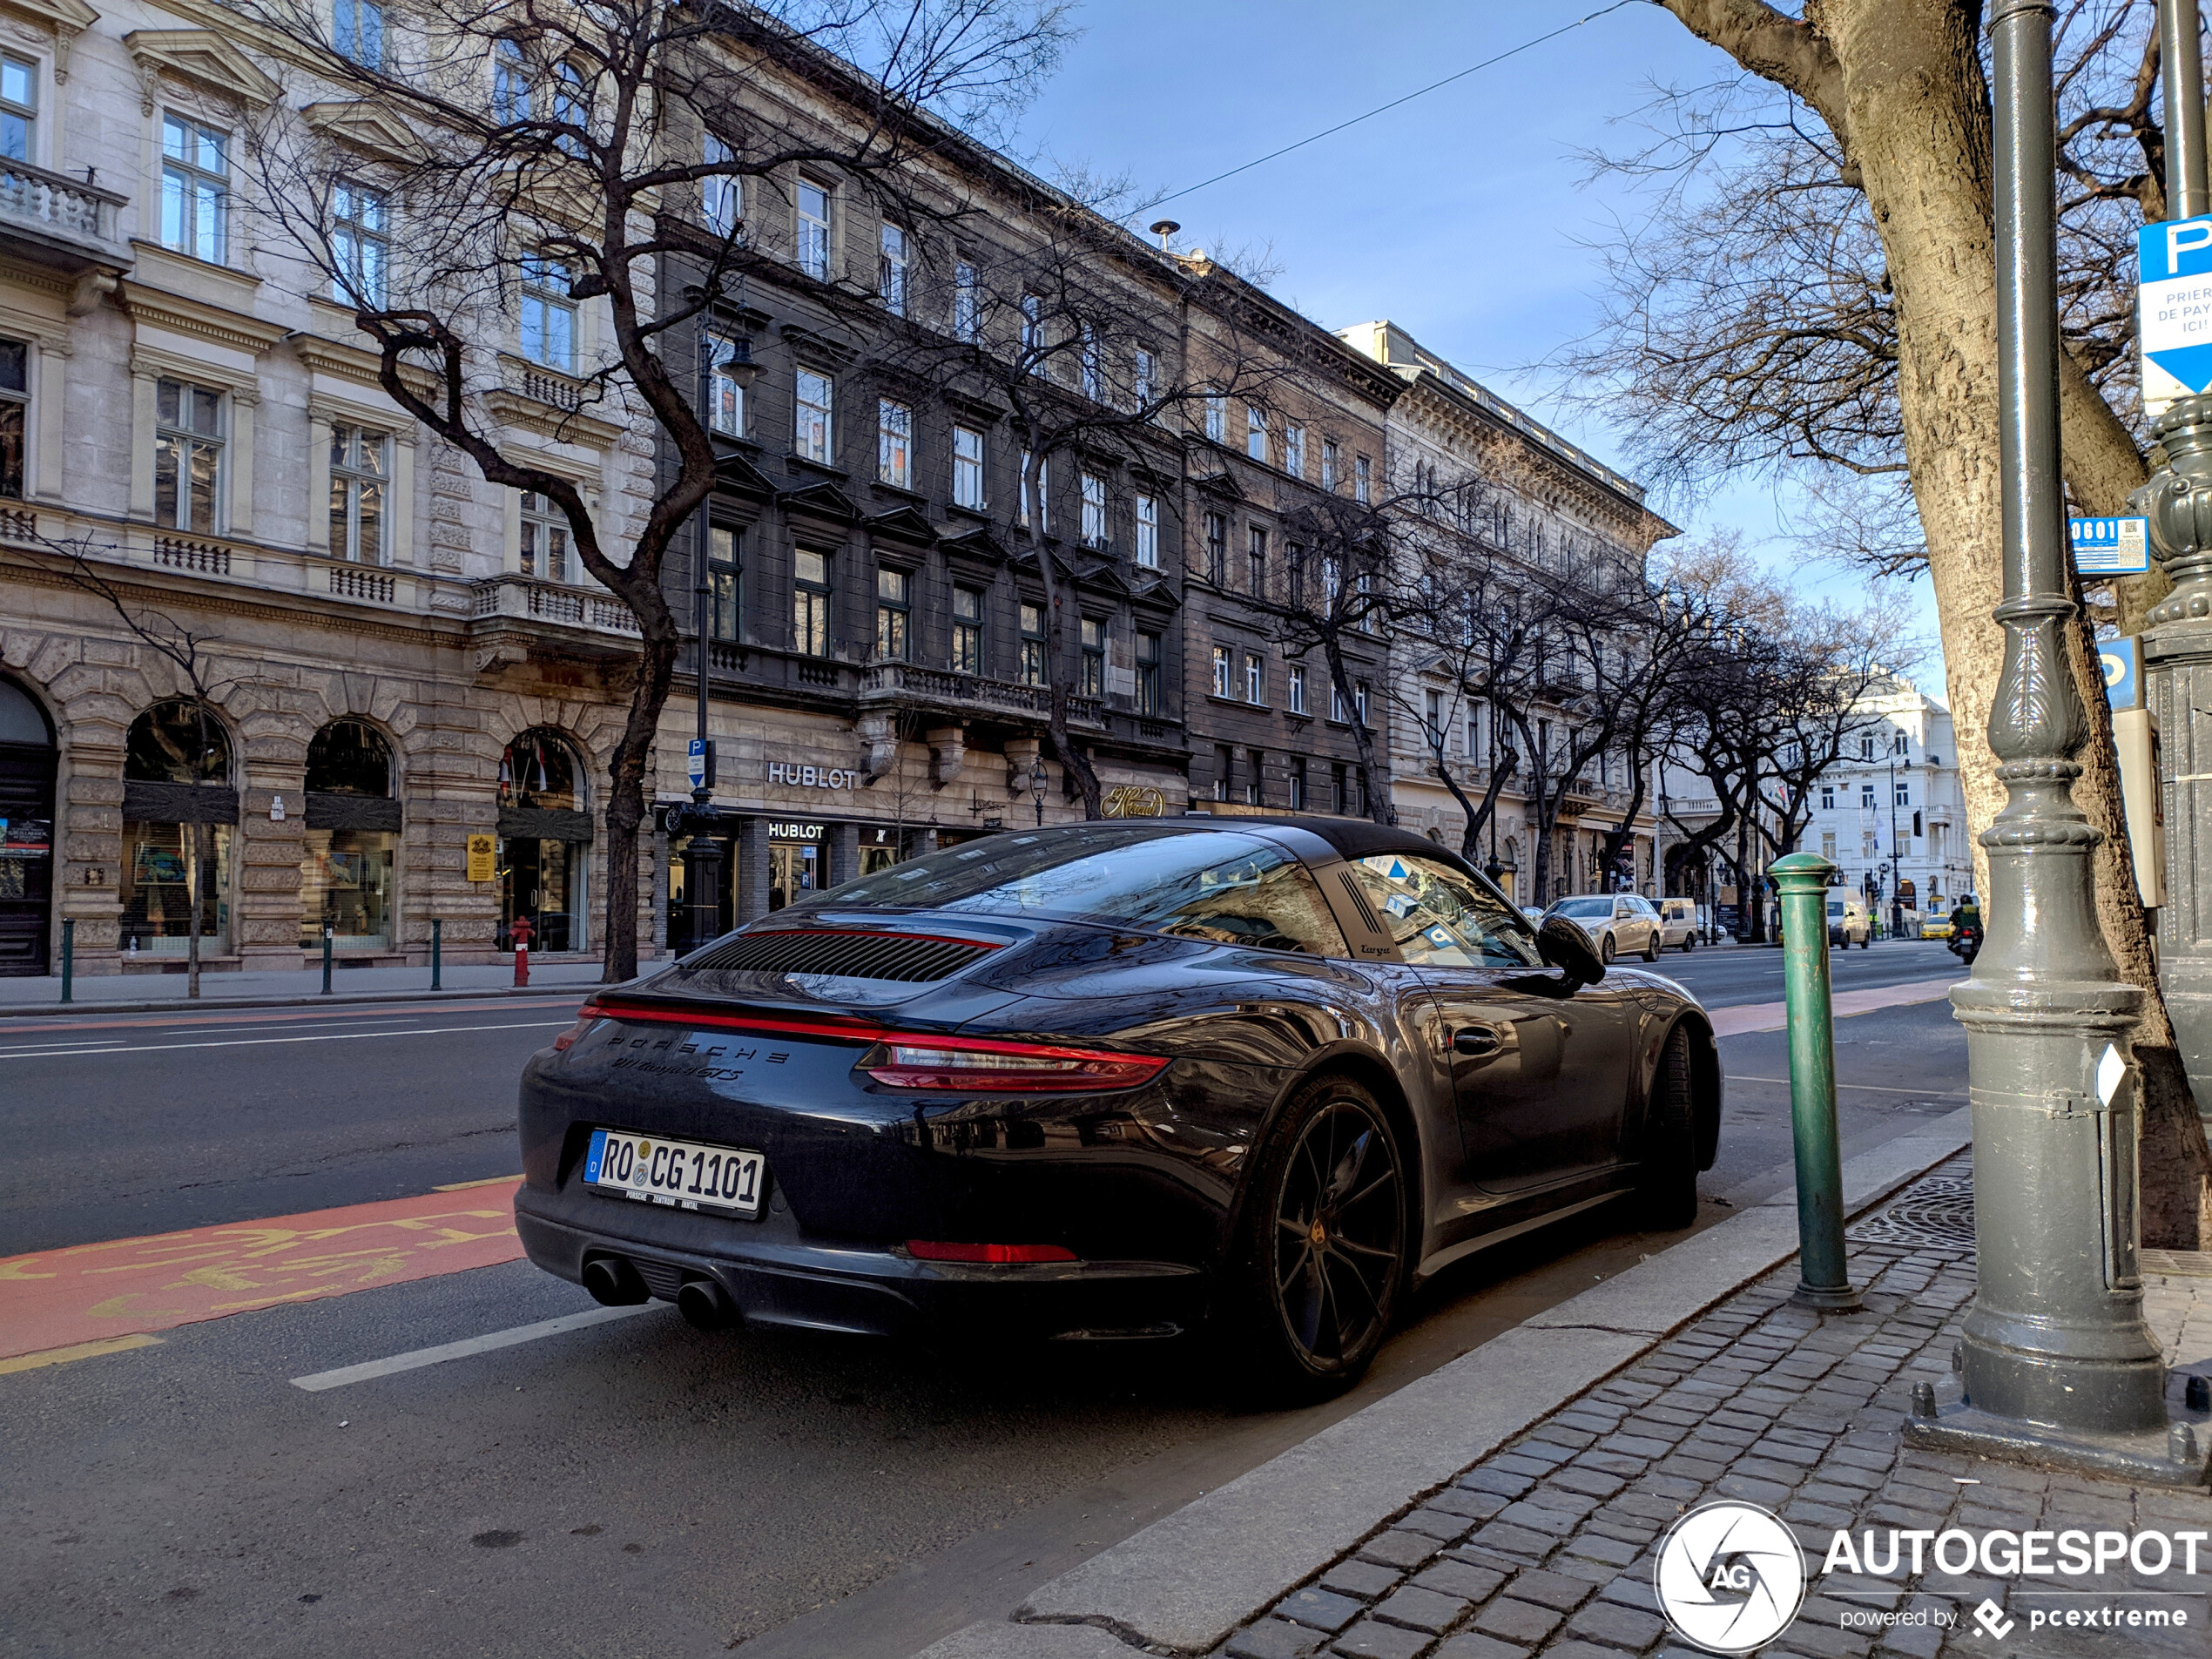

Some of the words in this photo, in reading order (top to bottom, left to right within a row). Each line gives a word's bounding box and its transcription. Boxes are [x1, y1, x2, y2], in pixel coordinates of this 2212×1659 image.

[2167, 219, 2212, 274] P
[2158, 308, 2178, 321] DE
[2183, 319, 2208, 333] ICI!
[2071, 521, 2116, 541] 0601
[692, 740, 702, 755] P
[768, 762, 856, 790] HUBLOT
[769, 823, 824, 839] HUBLOT
[608, 1036, 790, 1064] PORSCHE
[590, 1162, 597, 1173] D
[601, 1139, 634, 1181] RO
[651, 1146, 685, 1190] CG
[687, 1151, 758, 1203] 1101
[625, 1190, 648, 1202] PORSCHE
[651, 1195, 676, 1206] ZENTRUM
